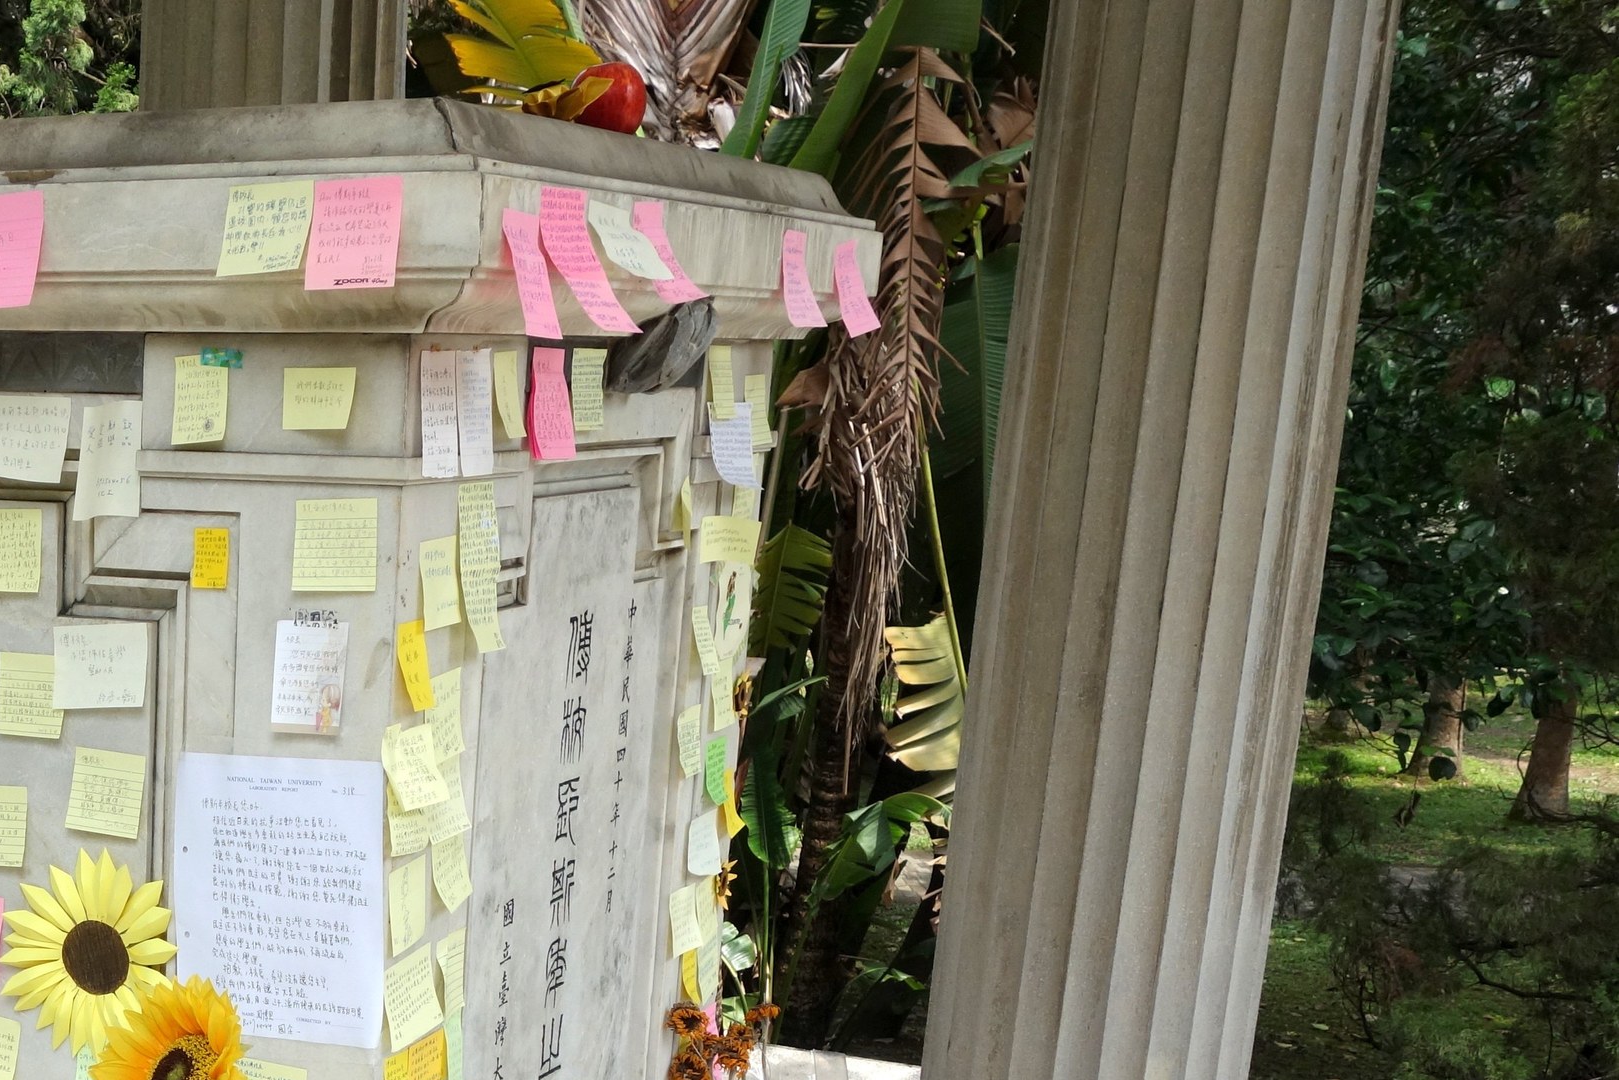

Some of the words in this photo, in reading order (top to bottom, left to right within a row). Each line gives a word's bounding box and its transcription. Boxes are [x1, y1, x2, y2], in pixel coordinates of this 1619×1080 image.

[333, 277, 370, 287] ZOCOR
[604, 597, 638, 915] 中華民國四十年十二月
[226, 775, 255, 784] NATIONAL
[260, 777, 283, 785] TAIWAN
[287, 779, 323, 787] UNIVERSITY
